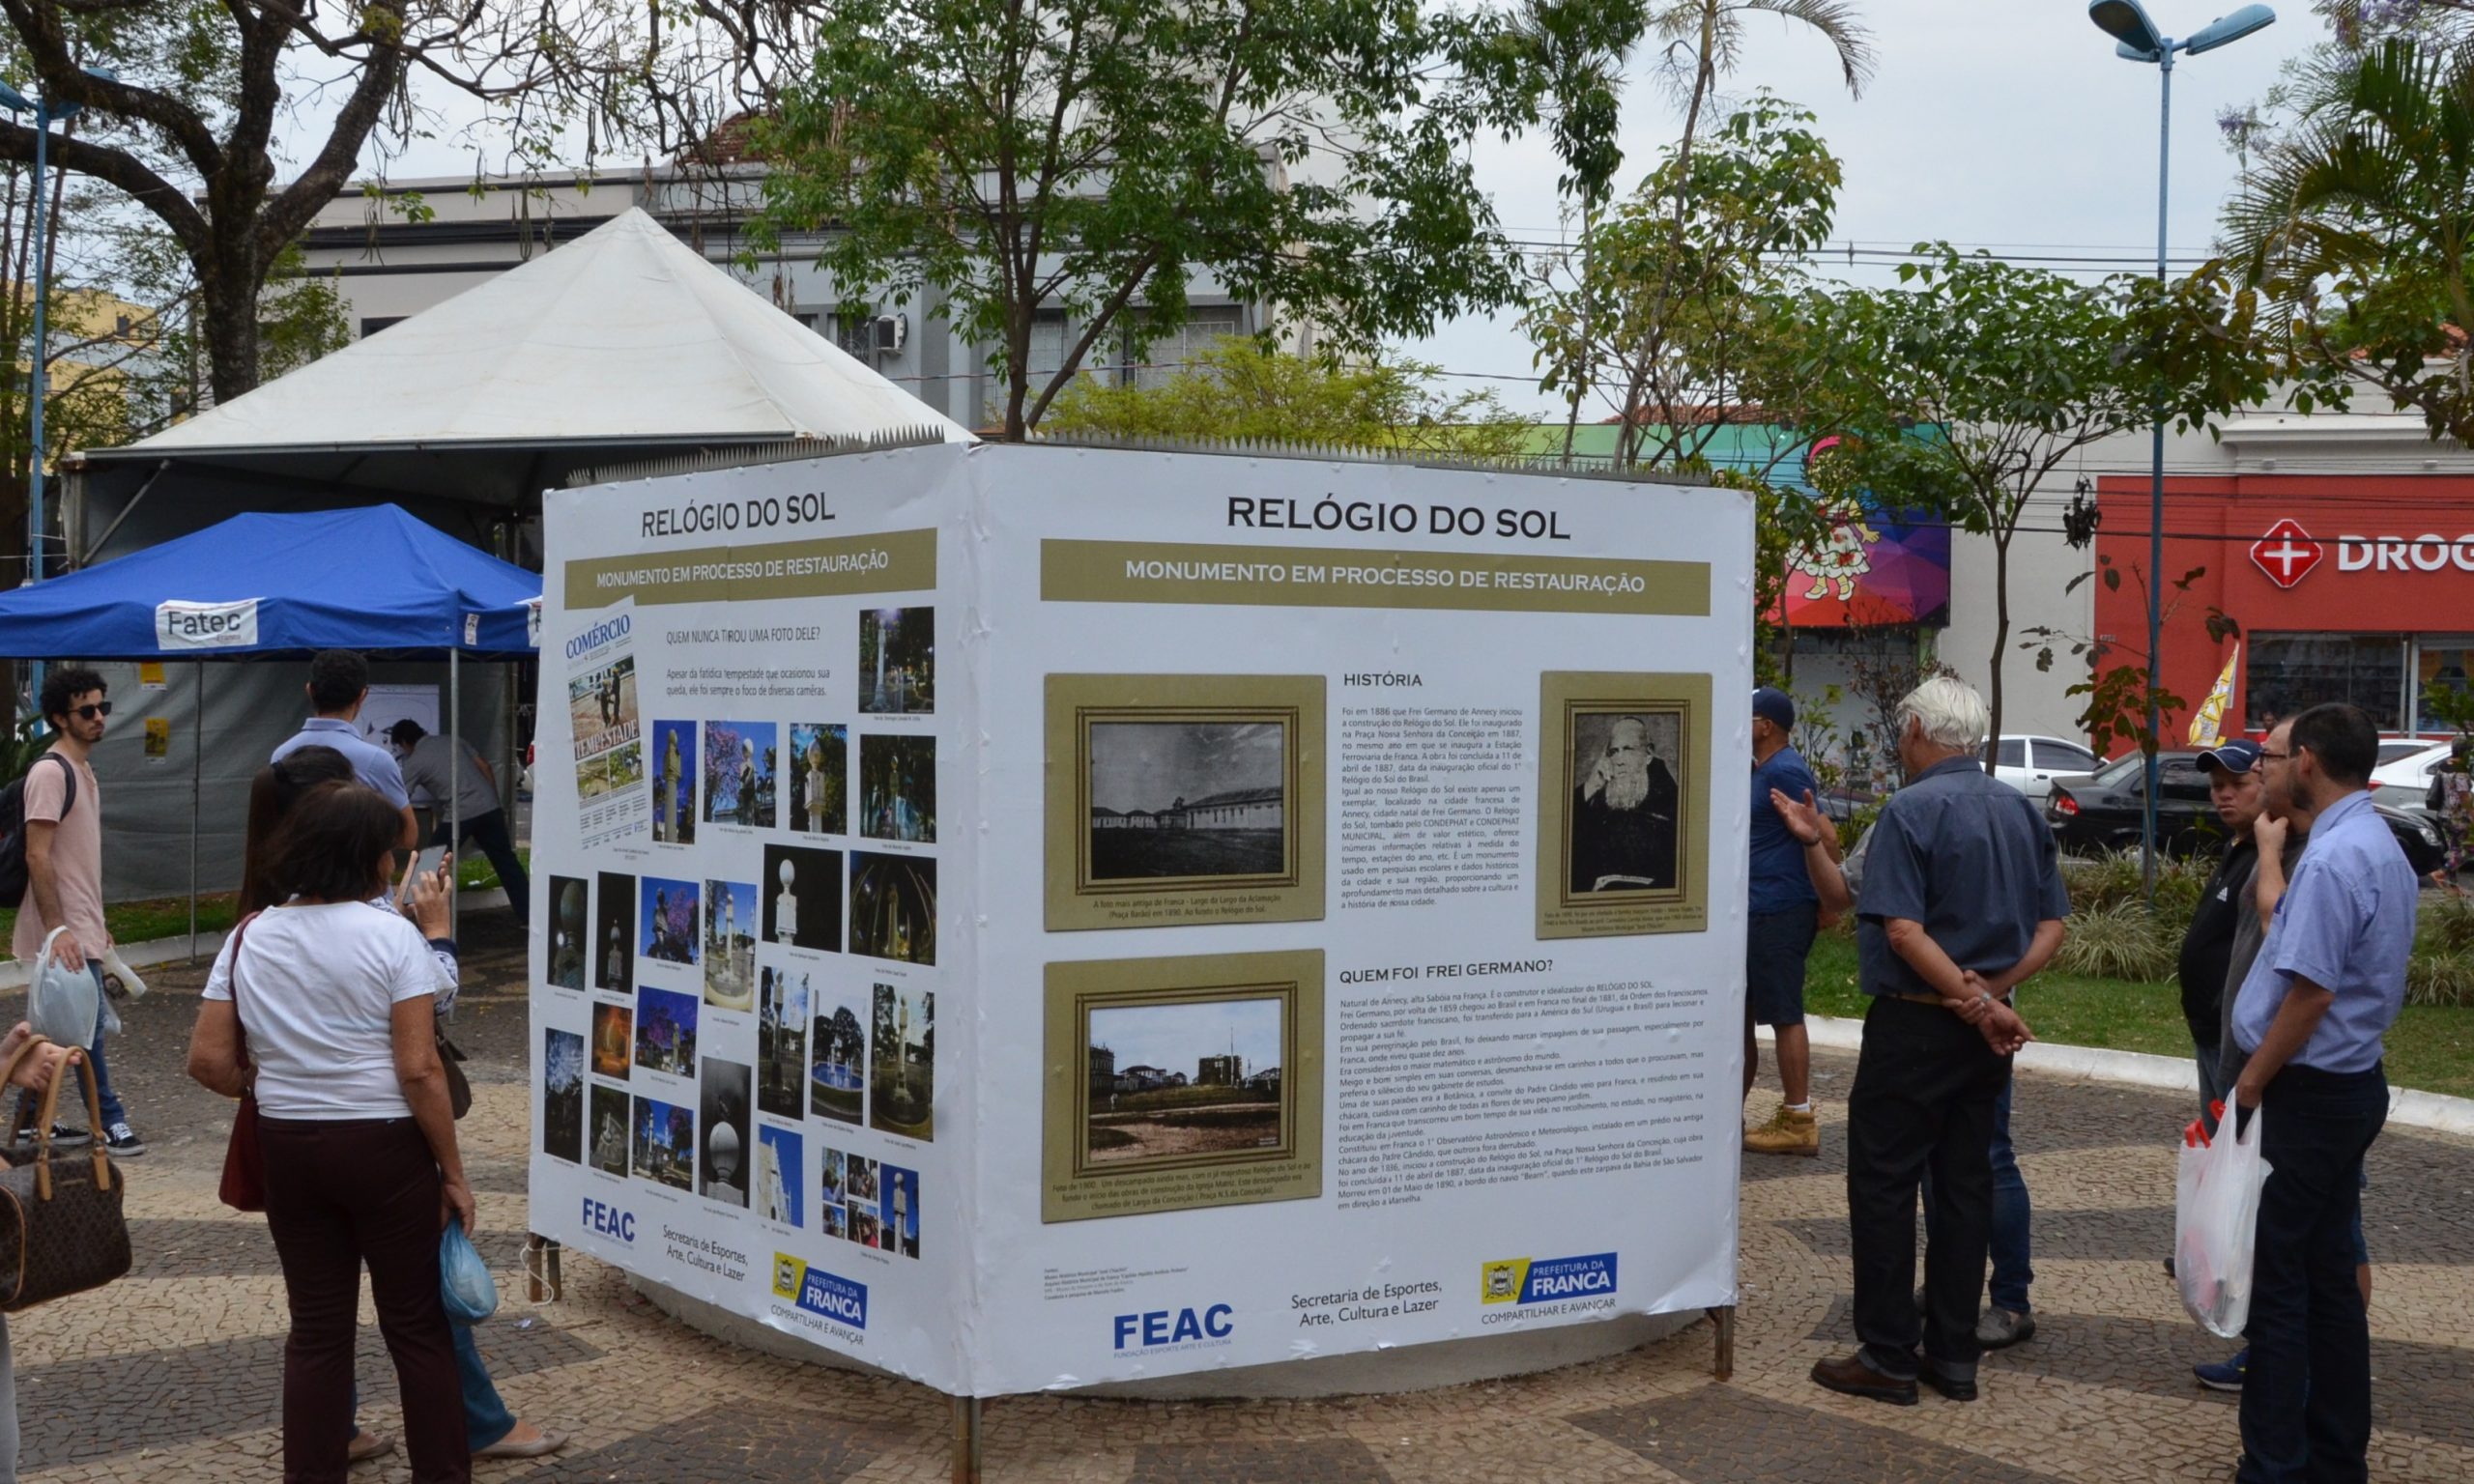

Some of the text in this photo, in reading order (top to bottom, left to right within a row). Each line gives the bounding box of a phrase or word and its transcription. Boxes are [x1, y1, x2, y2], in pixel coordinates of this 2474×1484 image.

[642, 493, 835, 538] RELÓGIO DO SOL
[1227, 494, 1570, 540] RELÓGIO DO SOL
[2338, 533, 2474, 571] DROG
[596, 549, 888, 587] MONUMENTO EM PROCESSO DE RESTAURAÇÃO
[1126, 559, 1645, 596] MONUMENTO EM PROCESSO DE RESTAURAÇÃO
[168, 611, 241, 635] Fatec
[565, 614, 630, 660] COMÉRCIO
[667, 627, 820, 645] QUEM NUNCA TIROU UMA FOTO DELE?
[667, 669, 687, 681] Apesar
[690, 669, 698, 678] da
[766, 671, 779, 680] que
[818, 670, 830, 678] sua
[1344, 671, 1422, 686] HISTÓRIA
[689, 685, 699, 695] ele
[700, 684, 708, 695] foi
[710, 687, 734, 697] sempre
[742, 685, 757, 696] foco
[759, 685, 766, 696] de
[768, 684, 794, 696] diversas
[1348, 719, 1391, 728] construção
[1403, 719, 1430, 728] Relógio
[1482, 719, 1522, 728] inaugurado
[1471, 708, 1496, 717] Annecy
[574, 718, 639, 760] TEMPESTADE
[1355, 729, 1375, 739] Praça
[1448, 729, 1484, 739] Conceição
[1341, 786, 1361, 796] Igual
[1401, 785, 1427, 795] Relógio
[1347, 899, 1375, 907] história
[1410, 897, 1437, 905] cidade.
[1339, 959, 1553, 984] QUEM FOI FREI GERMANO?
[583, 1197, 635, 1242] FEAC
[663, 1225, 748, 1266] Secretaria de Esportes,
[667, 1244, 745, 1282] Arte, Cultura e Lazer
[1533, 1260, 1604, 1276] PREFEITURA DA
[807, 1273, 858, 1298] PREFEITURA DA
[1291, 1278, 1442, 1309] Secretaria de Esportes,
[1532, 1270, 1611, 1297] FRANCA
[806, 1286, 862, 1323] FRANCA
[1299, 1298, 1439, 1327] Arte, Cultura e Lazer
[1482, 1298, 1616, 1325] COMPARTILHAR E AVANÇAR
[770, 1304, 864, 1347] COMPARTILHAR E AVANÇAR
[1114, 1303, 1233, 1350] FEAC
